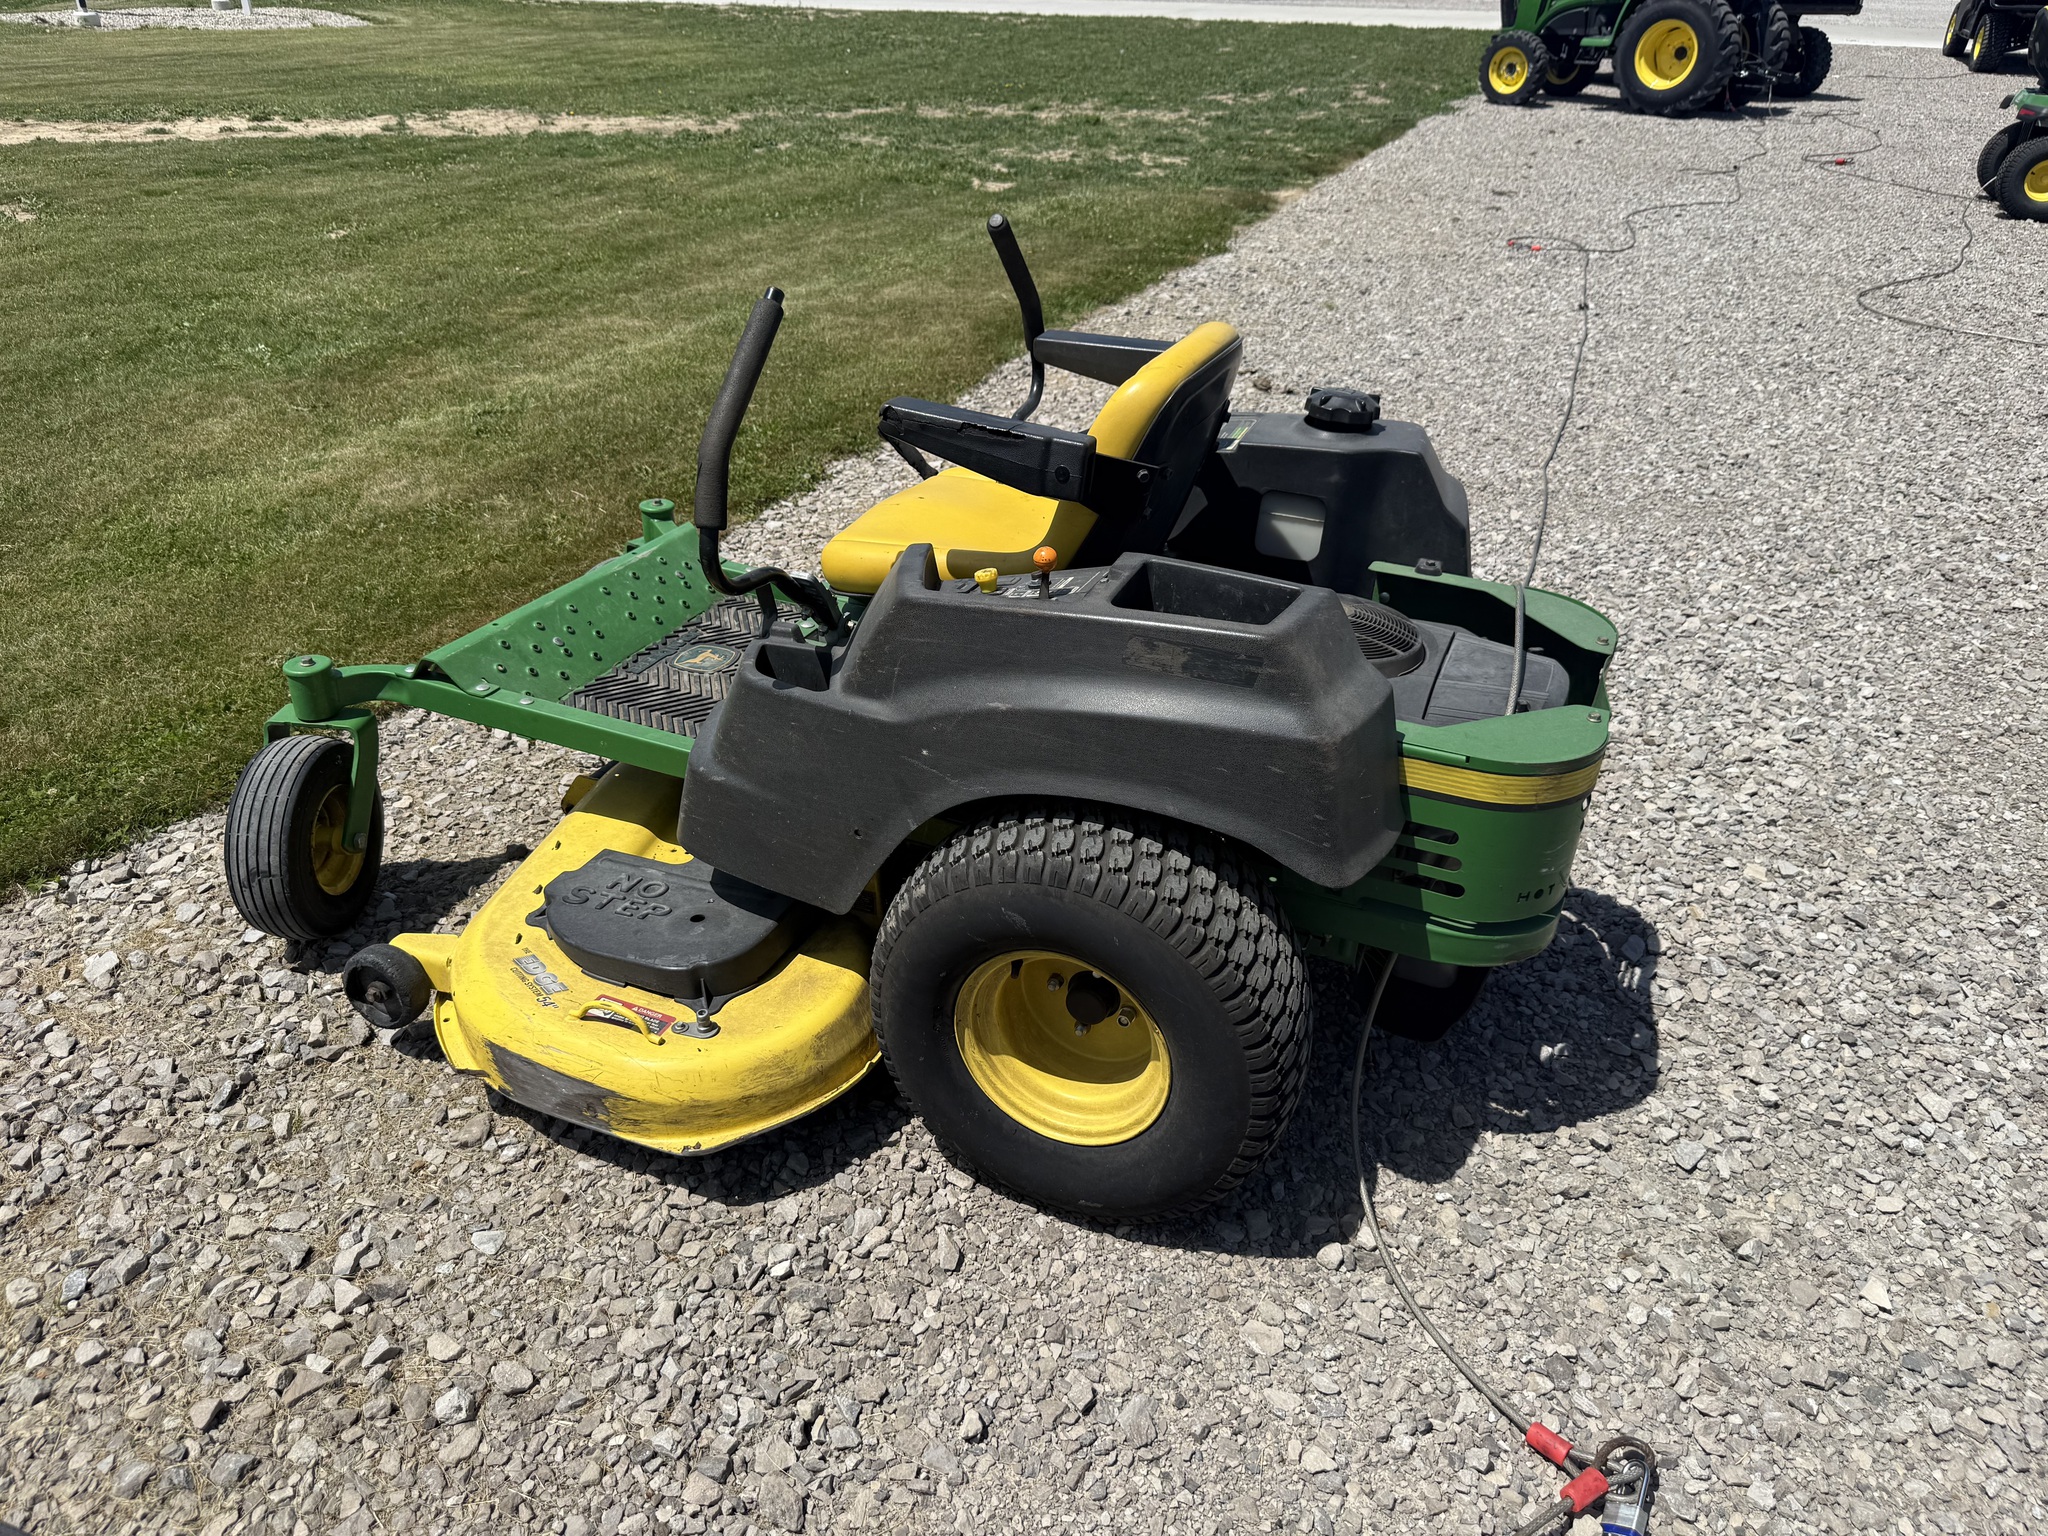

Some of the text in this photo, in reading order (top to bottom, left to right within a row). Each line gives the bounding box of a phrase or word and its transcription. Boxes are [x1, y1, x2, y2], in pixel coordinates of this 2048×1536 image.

[606, 873, 670, 898] NO
[1516, 883, 1556, 903] HOT
[562, 886, 673, 920] STEP
[512, 954, 570, 995] EDGE
[524, 980, 544, 998] SYSTEM
[536, 996, 559, 1009] 54"
[639, 1007, 663, 1019] DANGER
